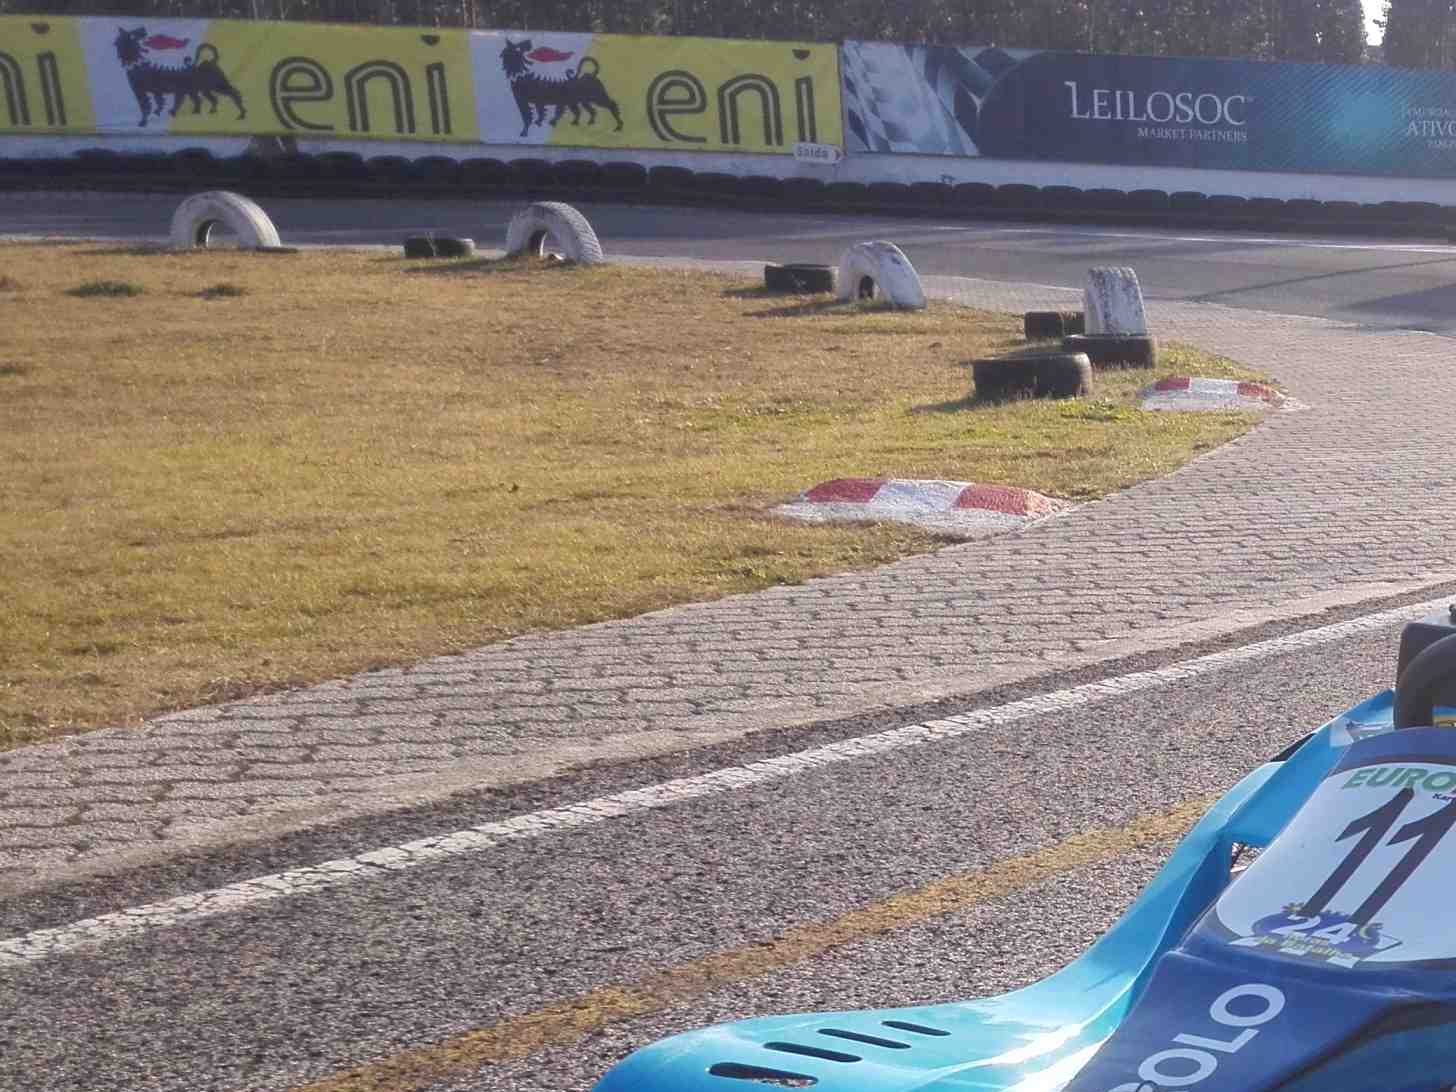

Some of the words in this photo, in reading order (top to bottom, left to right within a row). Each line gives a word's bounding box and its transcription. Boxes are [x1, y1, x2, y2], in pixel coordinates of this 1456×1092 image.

[270, 35, 450, 134] eni
[646, 48, 817, 146] eni
[1064, 80, 1247, 126] LEILOSOC
[1137, 126, 1185, 141] MARKET
[1186, 128, 1249, 144] PARTNERS
